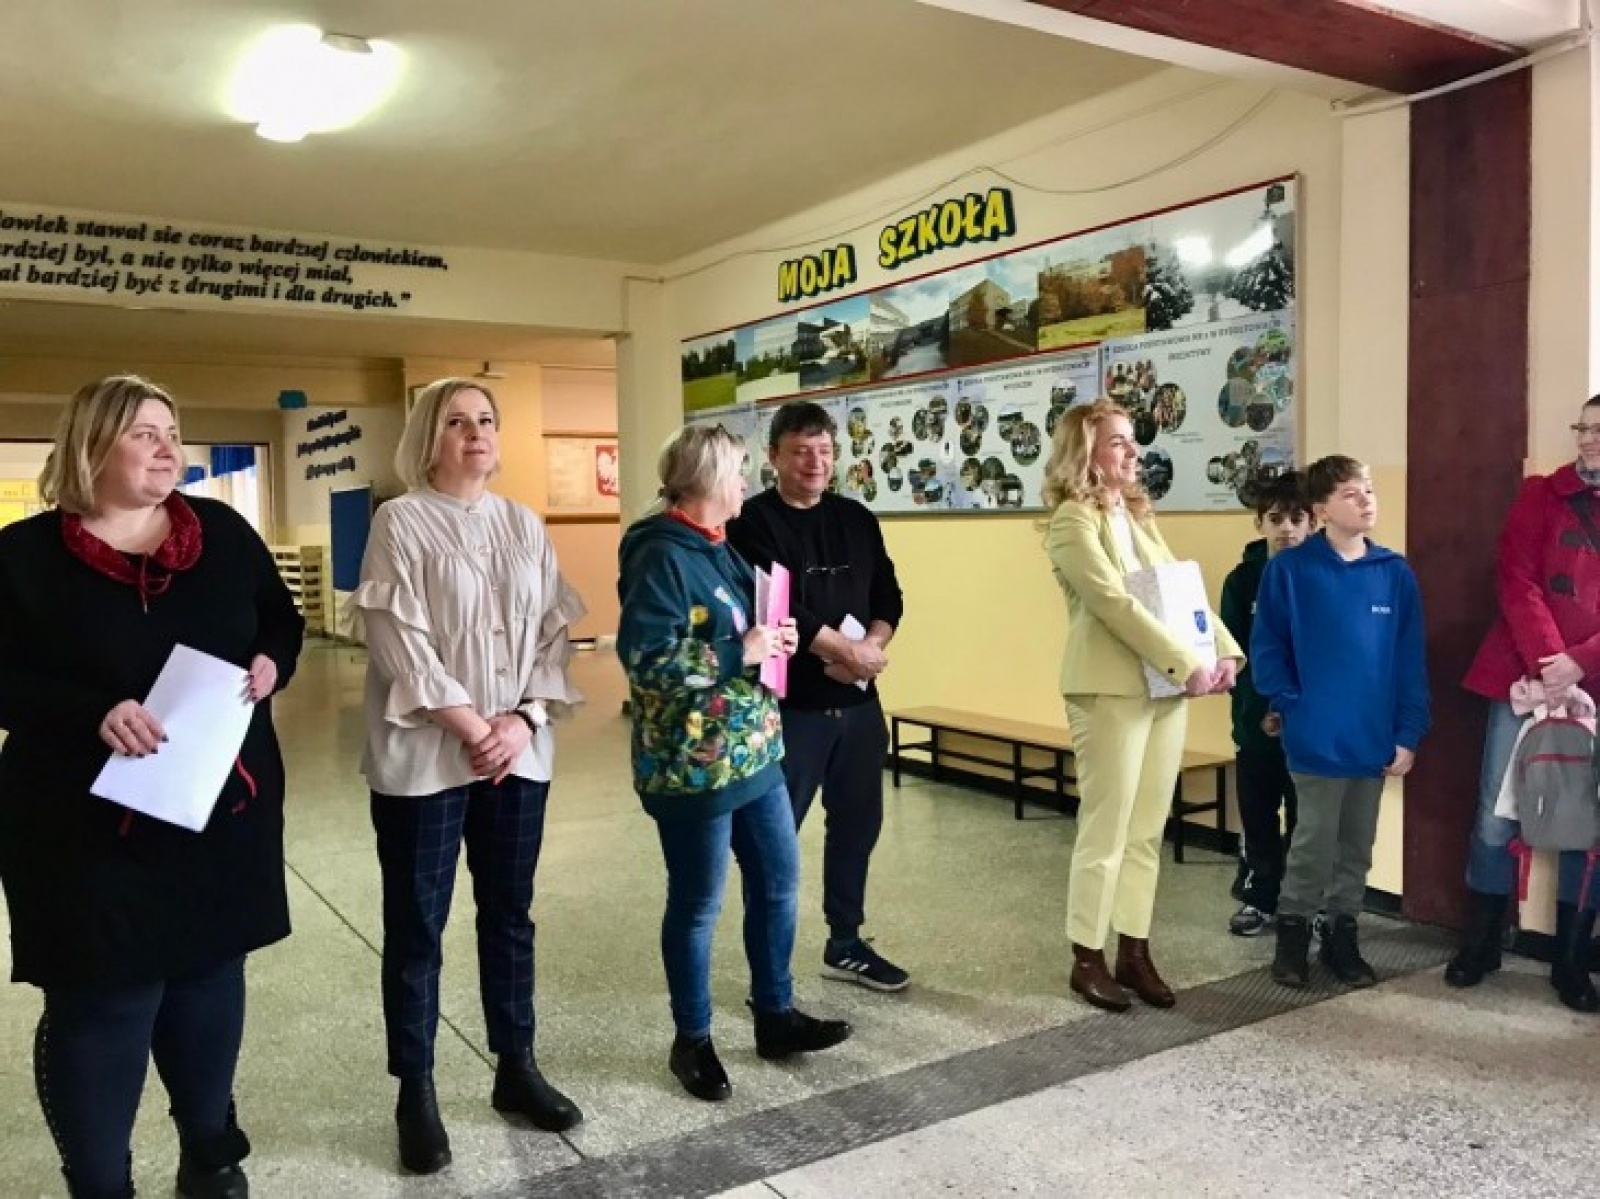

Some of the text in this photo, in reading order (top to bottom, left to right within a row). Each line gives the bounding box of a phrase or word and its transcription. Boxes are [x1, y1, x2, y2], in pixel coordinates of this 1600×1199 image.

[74, 243, 114, 267] był,
[120, 252, 135, 266] a
[141, 251, 175, 269] nie
[182, 253, 233, 274] tylko
[239, 258, 299, 283] więcej
[305, 265, 353, 285] miał,
[75, 221, 147, 241] stawał
[188, 233, 244, 252] coraz
[333, 244, 447, 270] człowiekiem,
[778, 187, 1016, 302] MOJA SZKOŁA
[26, 264, 119, 293] bardziej
[125, 272, 162, 296] być
[169, 279, 179, 294] z
[185, 276, 267, 300] drugimi
[272, 282, 281, 299] i
[285, 284, 316, 301] dla
